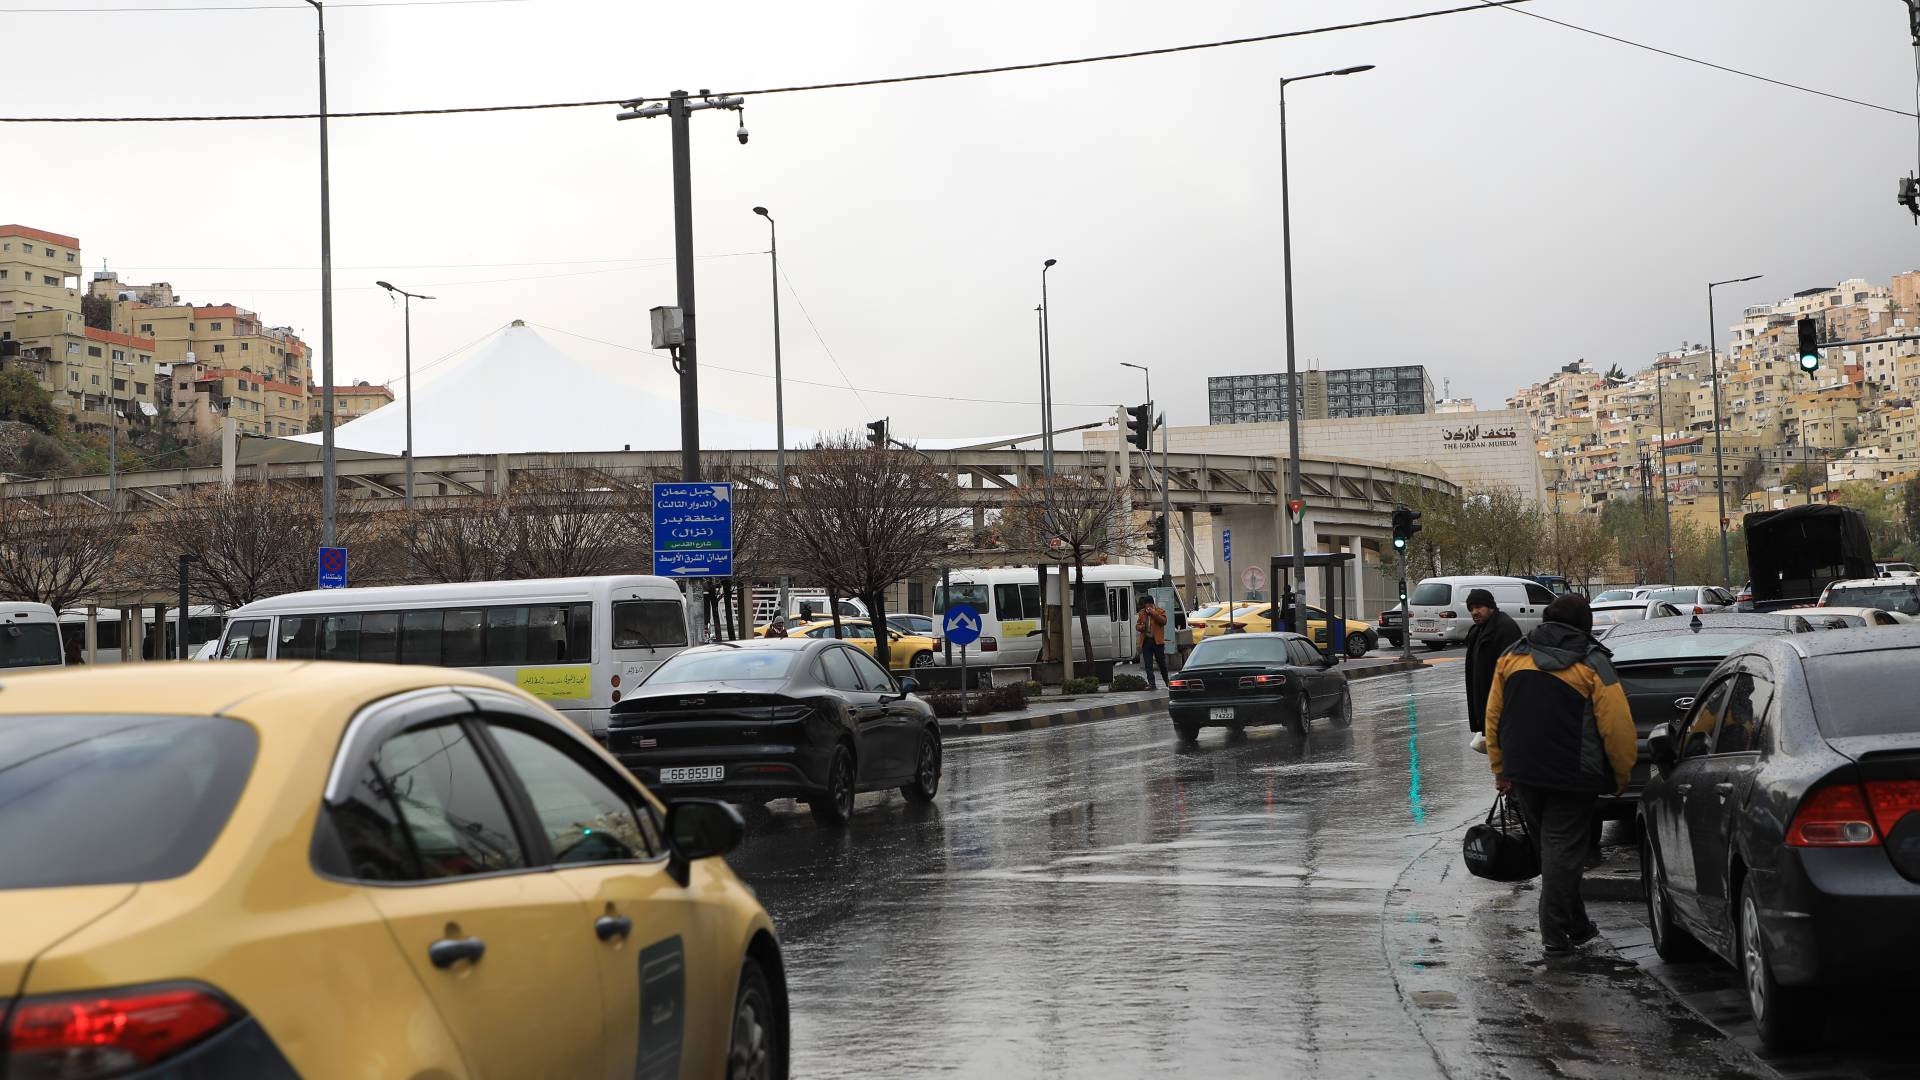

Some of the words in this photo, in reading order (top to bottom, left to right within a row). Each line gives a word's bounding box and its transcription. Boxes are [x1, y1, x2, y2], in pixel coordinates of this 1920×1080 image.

[1460, 441, 1486, 450] JORDAN
[1488, 440, 1517, 448] MUSEUM
[661, 487, 687, 497] عمان
[689, 487, 712, 496] جبل
[660, 516, 683, 525] بدر
[685, 514, 724, 522] منطقة
[672, 528, 713, 537] (نزال)
[695, 541, 712, 549] شارع
[658, 552, 684, 563] الأوسط
[684, 553, 705, 563] الشرق
[706, 553, 728, 563] ميدان
